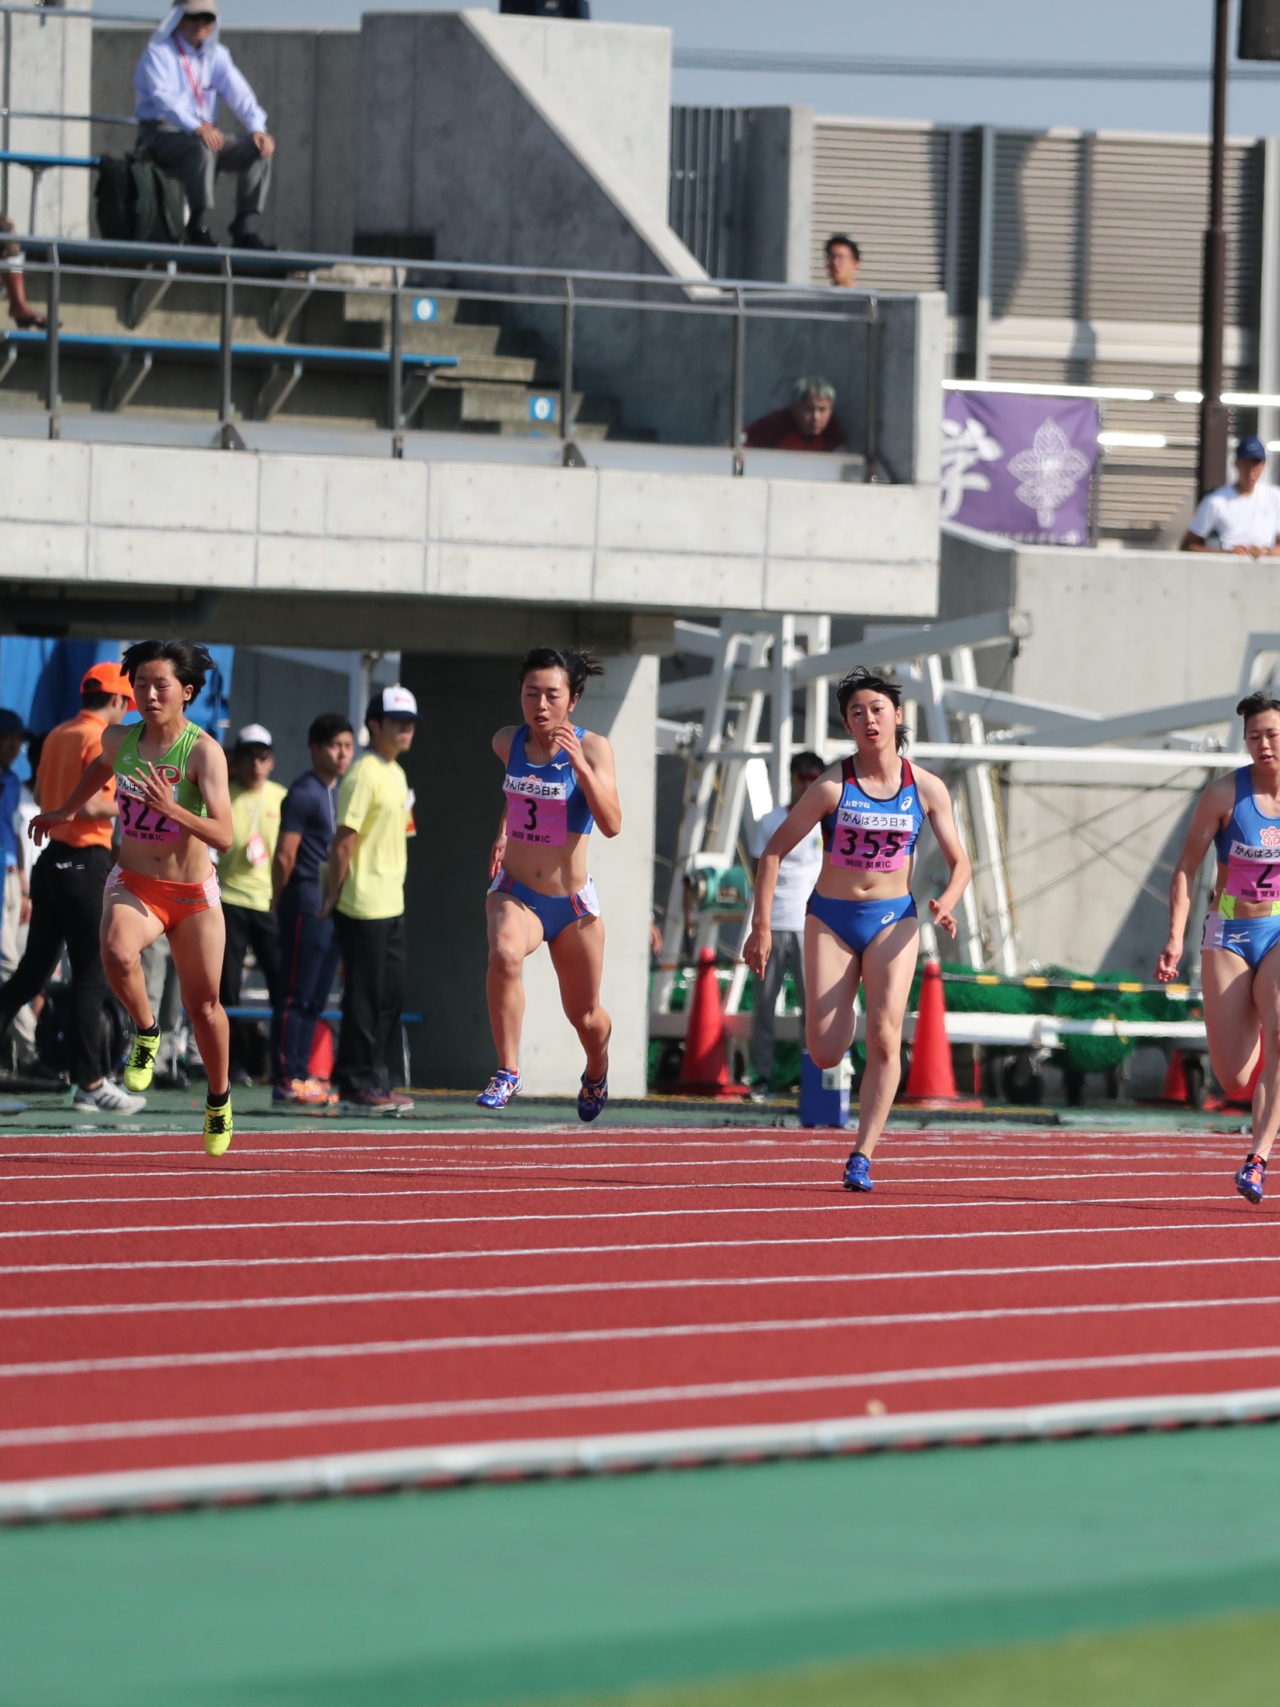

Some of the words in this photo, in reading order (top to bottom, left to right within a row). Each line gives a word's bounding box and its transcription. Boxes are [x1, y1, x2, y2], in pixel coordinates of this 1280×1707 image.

[524, 798, 538, 831] 3
[842, 813, 908, 827] がんばろう日本
[840, 829, 904, 859] 355
